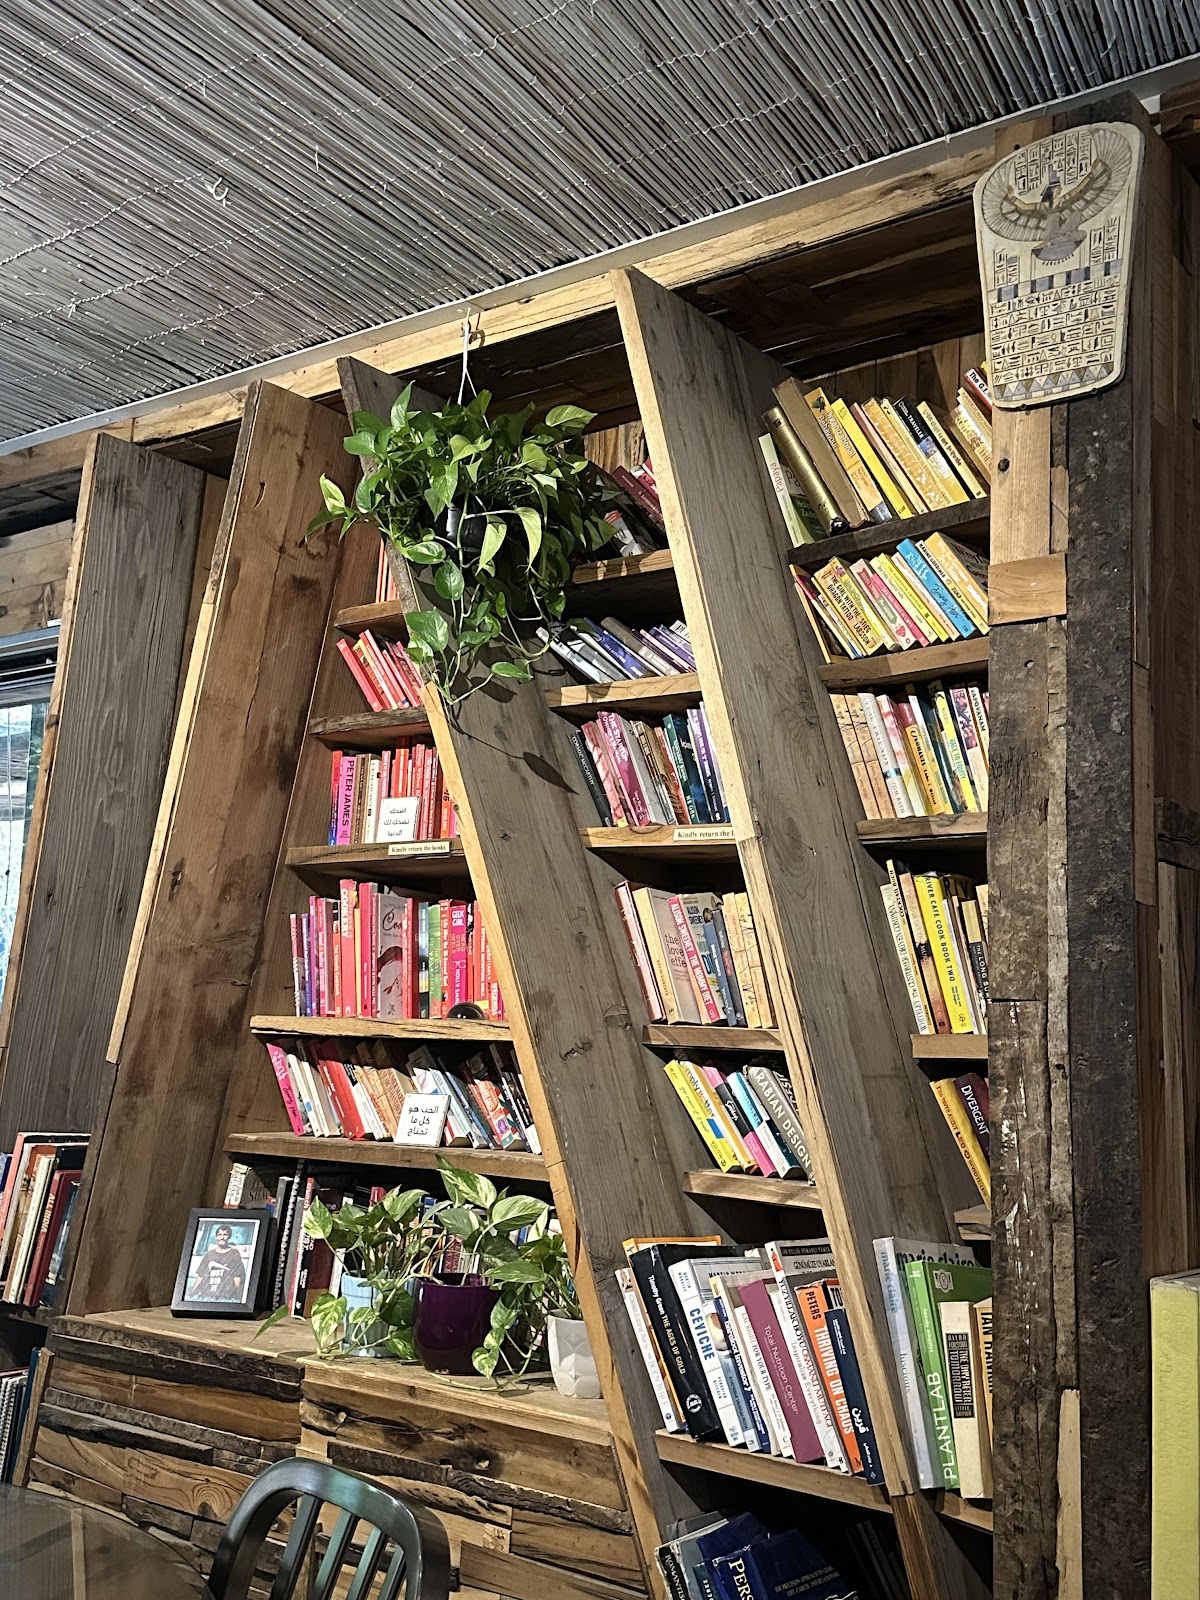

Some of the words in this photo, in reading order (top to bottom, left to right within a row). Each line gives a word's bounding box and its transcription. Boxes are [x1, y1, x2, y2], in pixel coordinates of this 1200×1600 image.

[969, 371, 980, 383] The
[816, 415, 840, 449] Behaviour
[824, 410, 855, 457] Organizational
[906, 414, 924, 439] TRAVELER
[768, 461, 786, 492] Papaya
[918, 542, 932, 559] NADINE
[929, 558, 946, 577] GORDIMER
[829, 575, 839, 586] THE
[835, 584, 846, 597] GIRL
[842, 595, 854, 609] WITH
[850, 606, 861, 618] THE
[857, 618, 871, 634] STIEG
[929, 582, 951, 607] Jenny
[826, 583, 842, 603] DRAGON
[838, 601, 854, 621] TATTOO
[852, 623, 870, 645] LARSSON
[607, 713, 618, 729] THE
[602, 716, 614, 741] OWNER'S
[610, 741, 621, 764] MANUAL
[612, 729, 629, 762] STARTUP
[344, 759, 354, 791] PETER
[955, 760, 966, 779] EQUITY
[341, 793, 351, 826] JAMES
[888, 869, 896, 886] BUCH
[339, 888, 349, 938] COOKERY
[670, 902, 685, 925] ALISON
[893, 888, 904, 917] COCKTAIL
[664, 934, 679, 945] the
[678, 924, 694, 952] SWEENEY
[924, 876, 934, 898] RIVER
[930, 900, 939, 917] CAFE
[935, 919, 944, 939] COOK
[940, 941, 950, 962] BOOK
[946, 965, 955, 981] TWO
[667, 945, 683, 957] love
[688, 954, 699, 966] THE
[693, 967, 707, 990] MOMMY
[977, 955, 988, 978] LONG
[701, 991, 712, 1005] DIET
[282, 1084, 295, 1105] Jenny
[288, 1105, 299, 1118] Han
[408, 1106, 418, 1114] هو
[410, 1115, 417, 1123] ما
[418, 1115, 430, 1126] كل
[421, 1105, 439, 1113] الحب
[749, 1064, 785, 1119] ARABIAN
[781, 1118, 813, 1167] DESIGN
[961, 1084, 990, 1136] DIVERGENT
[407, 1126, 428, 1136] تحتاج
[303, 1182, 311, 1208] crunch
[879, 1251, 893, 1281] marie
[646, 1274, 660, 1297] Timothy
[682, 1272, 692, 1288] MARTIN
[655, 1297, 666, 1314] Green
[804, 1290, 821, 1320] PETERS
[885, 1283, 900, 1313] claire
[661, 1315, 671, 1328] THE
[688, 1307, 715, 1360] CEVICHE
[981, 1311, 993, 1335] IAN
[665, 1327, 677, 1345] AGES
[925, 1328, 935, 1352] Matthew
[671, 1345, 680, 1355] OF
[722, 1320, 739, 1353] barefoot
[732, 1353, 749, 1386] investor
[745, 1324, 756, 1343] RIGHT
[751, 1344, 760, 1357] FOR
[756, 1357, 766, 1376] YOUR
[762, 1375, 772, 1391] TYPE
[793, 1323, 806, 1347] BOYU
[801, 1347, 819, 1387] OSMANLI
[813, 1325, 839, 1377] THRIVING
[958, 1349, 968, 1363] THE
[675, 1355, 686, 1374] GOLD
[763, 1325, 776, 1345] Total
[771, 1347, 789, 1383] Nutrition
[784, 1384, 799, 1413] Center
[898, 1352, 914, 1393] luscious
[948, 1350, 963, 1403] TOMORROW
[960, 1364, 970, 1377] DAY
[647, 1360, 660, 1383] BODY
[655, 1383, 668, 1407] BIBLE
[716, 1376, 727, 1398] PERUVIAN
[790, 1341, 808, 1381] Inspiralize
[803, 1381, 823, 1425] Everything
[828, 1378, 844, 1395] ON
[961, 1380, 973, 1402] AFTER
[834, 1397, 855, 1434] CHAOS
[850, 1405, 869, 1434] قرين
[925, 1370, 956, 1480] PLANTLAB
